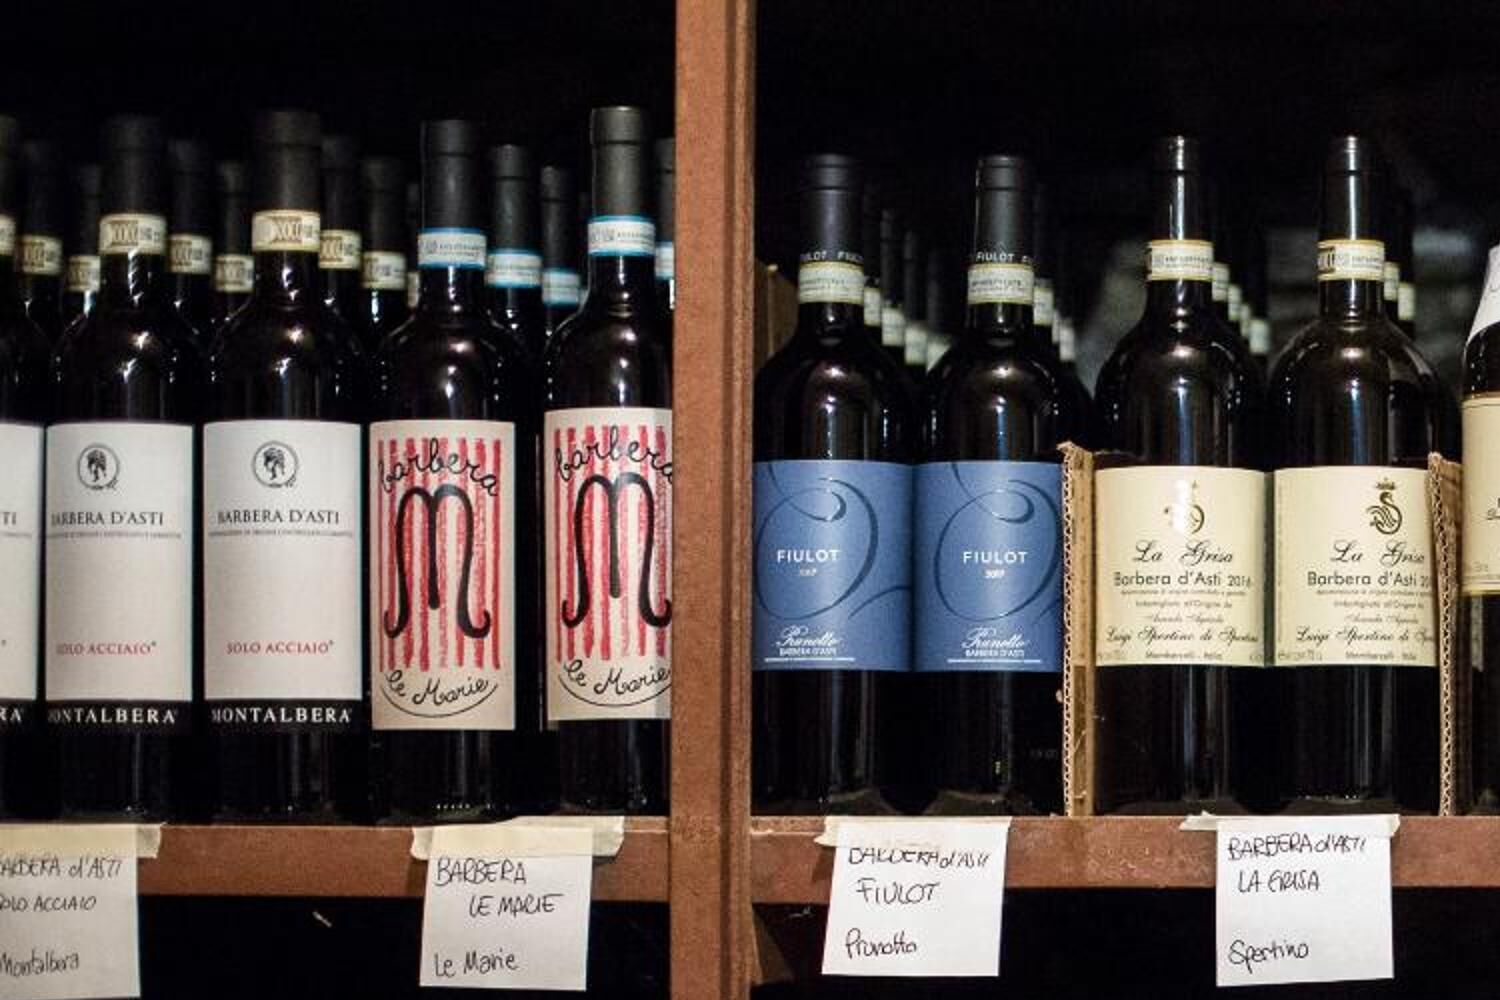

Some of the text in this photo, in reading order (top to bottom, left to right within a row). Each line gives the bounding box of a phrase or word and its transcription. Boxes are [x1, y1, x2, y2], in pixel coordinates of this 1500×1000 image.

[378, 437, 498, 498] barbera
[111, 512, 165, 526] D'ASTI
[217, 511, 340, 525] BARBERA D'ASTI
[776, 548, 841, 564] FIULOT
[962, 550, 1029, 566] FIULOT
[1132, 539, 1163, 564] La
[1330, 539, 1363, 564] La
[1113, 570, 1172, 588] Barbera
[1177, 570, 1222, 588] d'Asti
[1306, 570, 1372, 588] Barbera
[1378, 571, 1417, 587] d'Asti
[265, 641, 330, 655] ACCIAIO
[412, 676, 490, 706] Marie
[594, 663, 672, 695] Marie
[211, 707, 351, 724] MONTALBERA
[1227, 831, 1314, 862] BARBERA
[433, 856, 527, 887] BARBERA
[1237, 869, 1262, 894] LA
[33, 894, 97, 912] ACCIAIO
[855, 877, 941, 906] FIULOT
[468, 892, 565, 919] LE MARIE
[434, 947, 520, 978] Le Marie
[1227, 939, 1310, 975] Spertino
